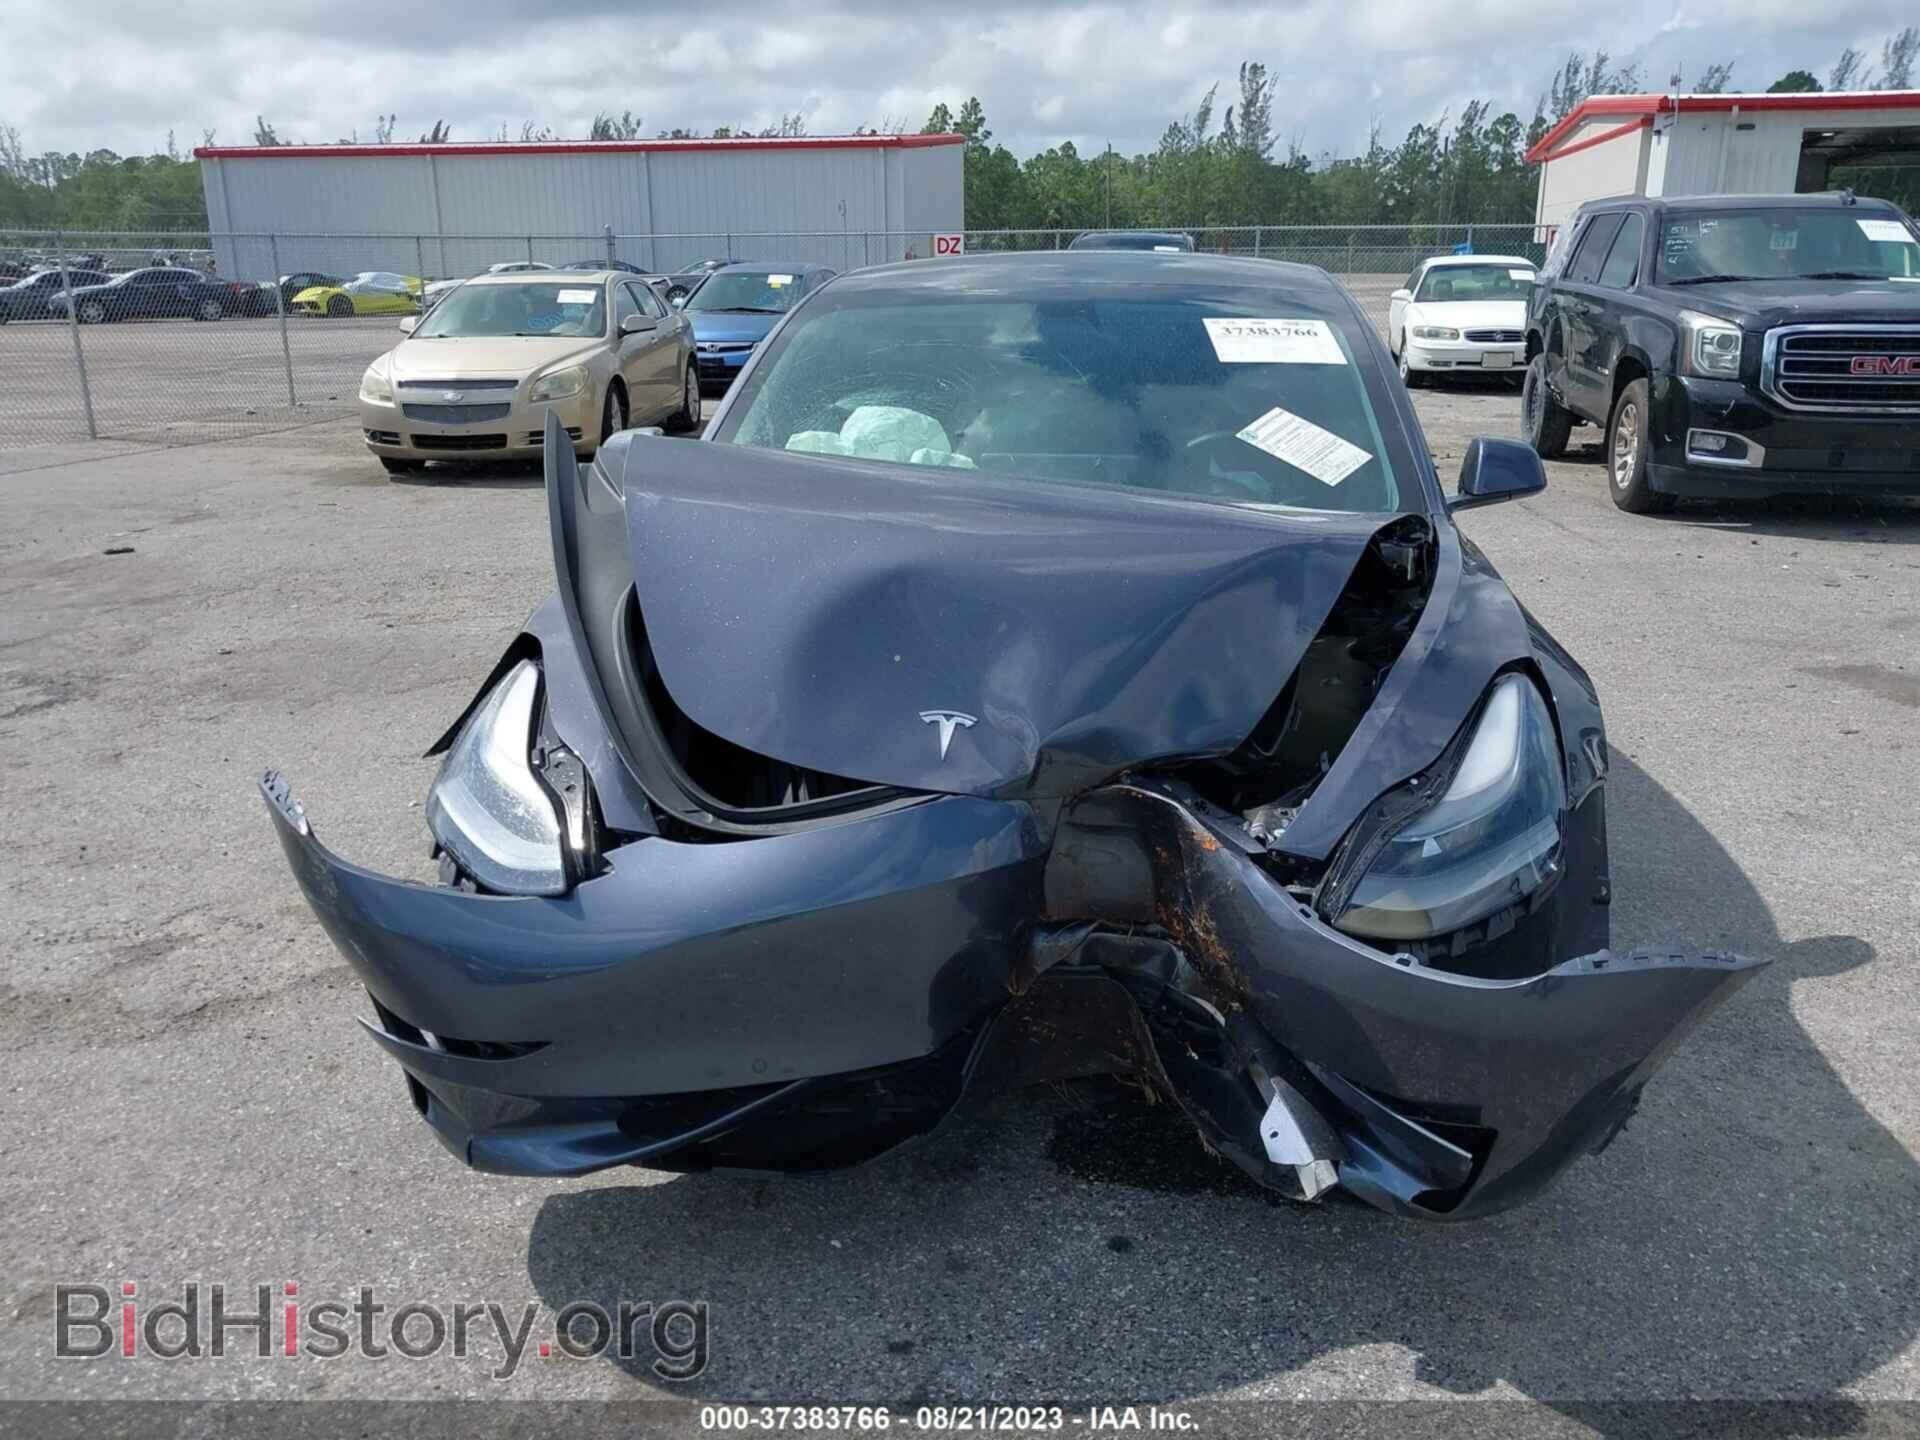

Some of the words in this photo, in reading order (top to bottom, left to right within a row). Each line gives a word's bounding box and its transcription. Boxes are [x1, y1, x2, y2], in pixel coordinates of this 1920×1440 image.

[937, 237, 961, 254] DZ
[1222, 327, 1319, 337] 37383766
[1850, 356, 1920, 374] GMC
